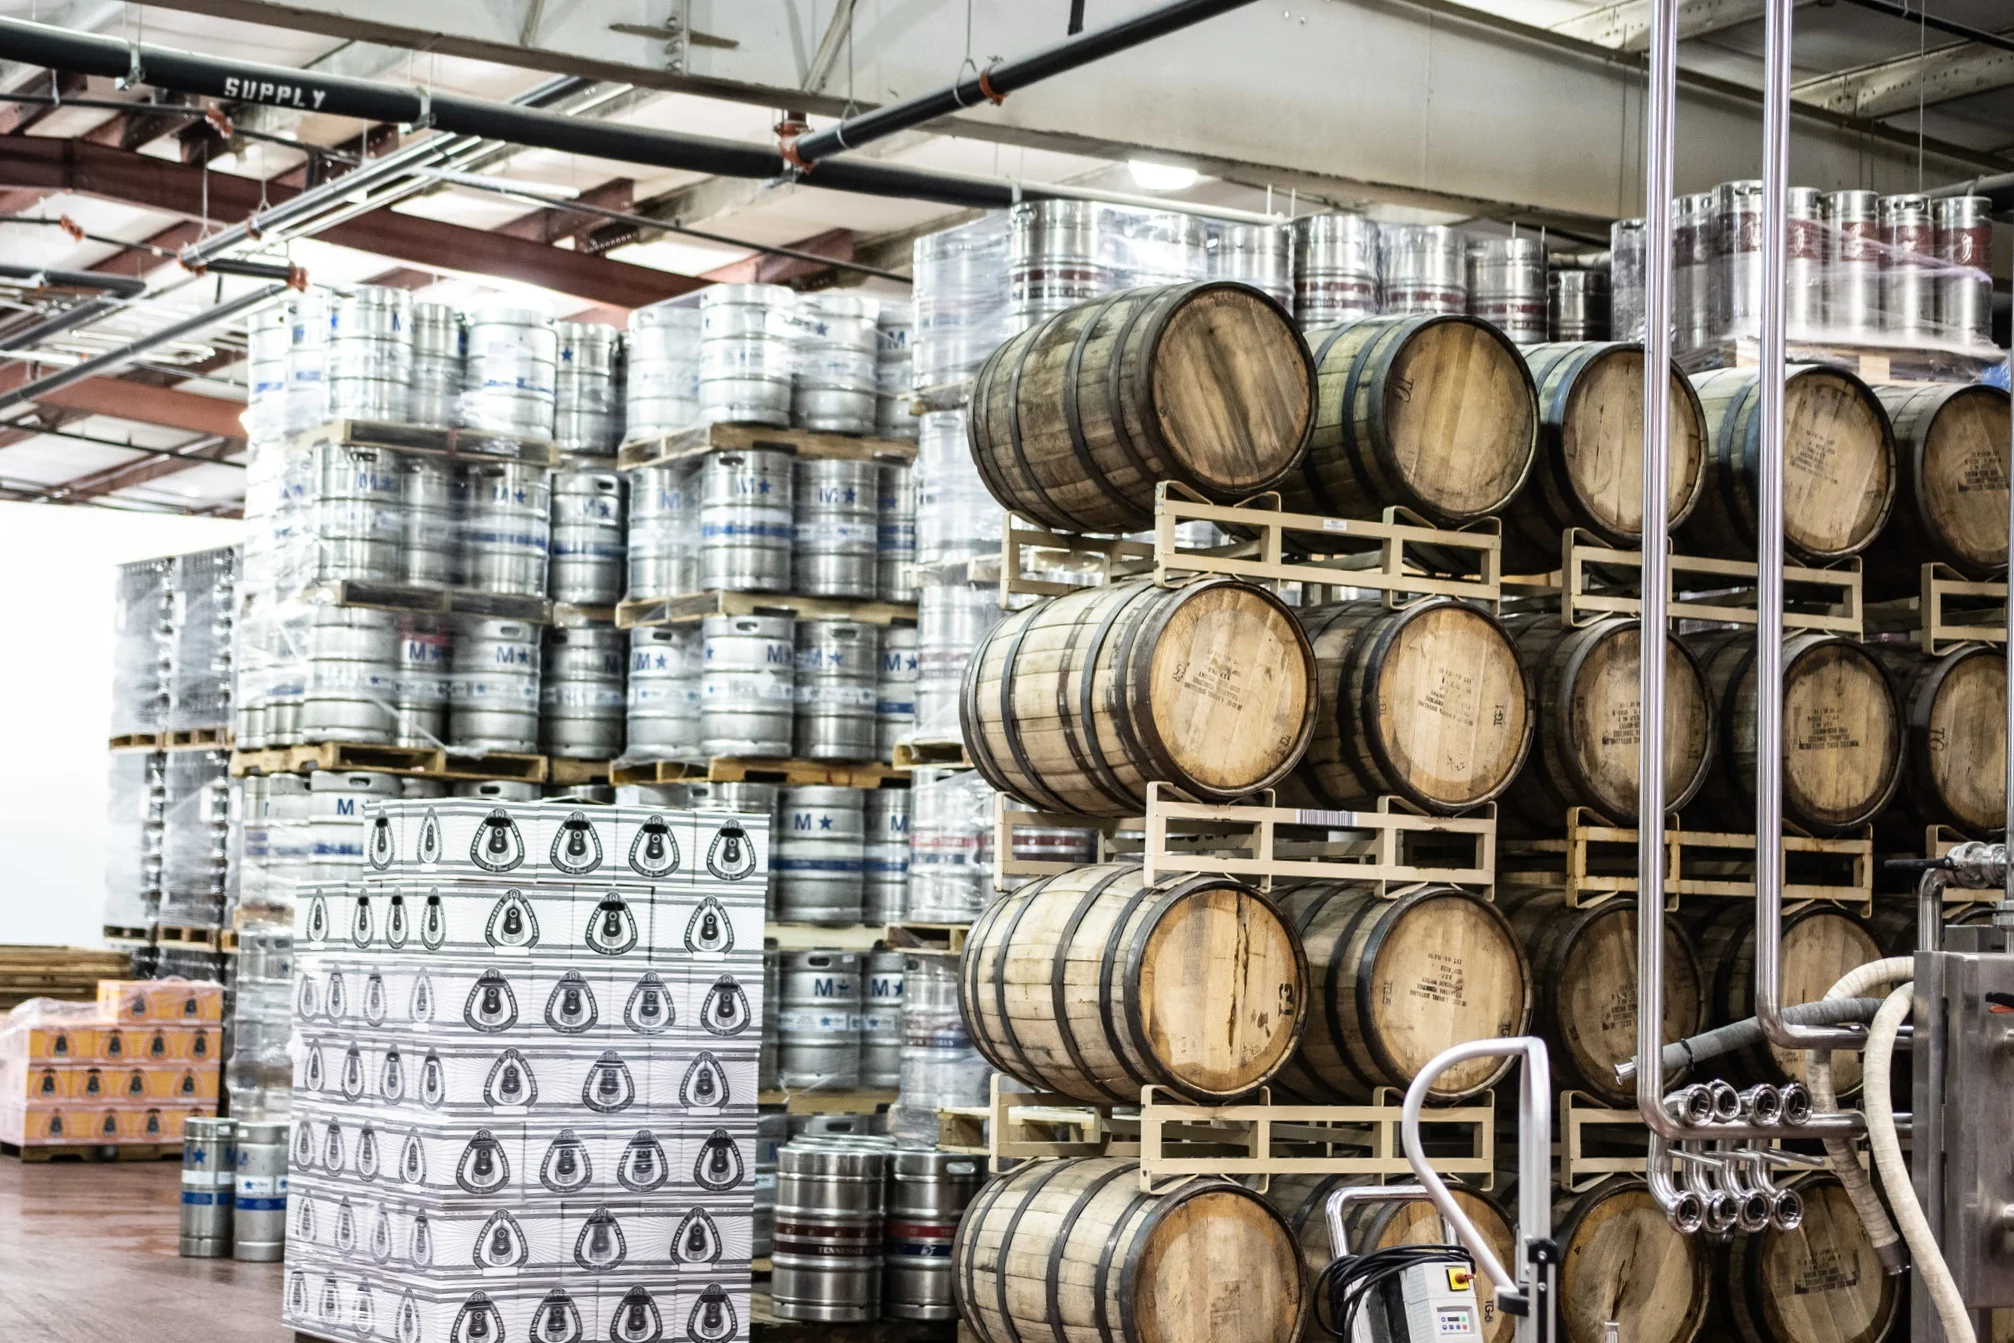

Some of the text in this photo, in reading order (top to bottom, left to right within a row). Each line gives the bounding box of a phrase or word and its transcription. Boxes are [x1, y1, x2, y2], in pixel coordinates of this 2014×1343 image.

[224, 76, 326, 110] SUPPLY
[496, 647, 514, 664] M
[768, 645, 785, 663] M
[885, 655, 901, 671] M
[337, 798, 354, 816] M
[795, 813, 811, 830] M
[891, 816, 908, 832] M
[816, 979, 833, 996] M
[872, 980, 888, 996] M
